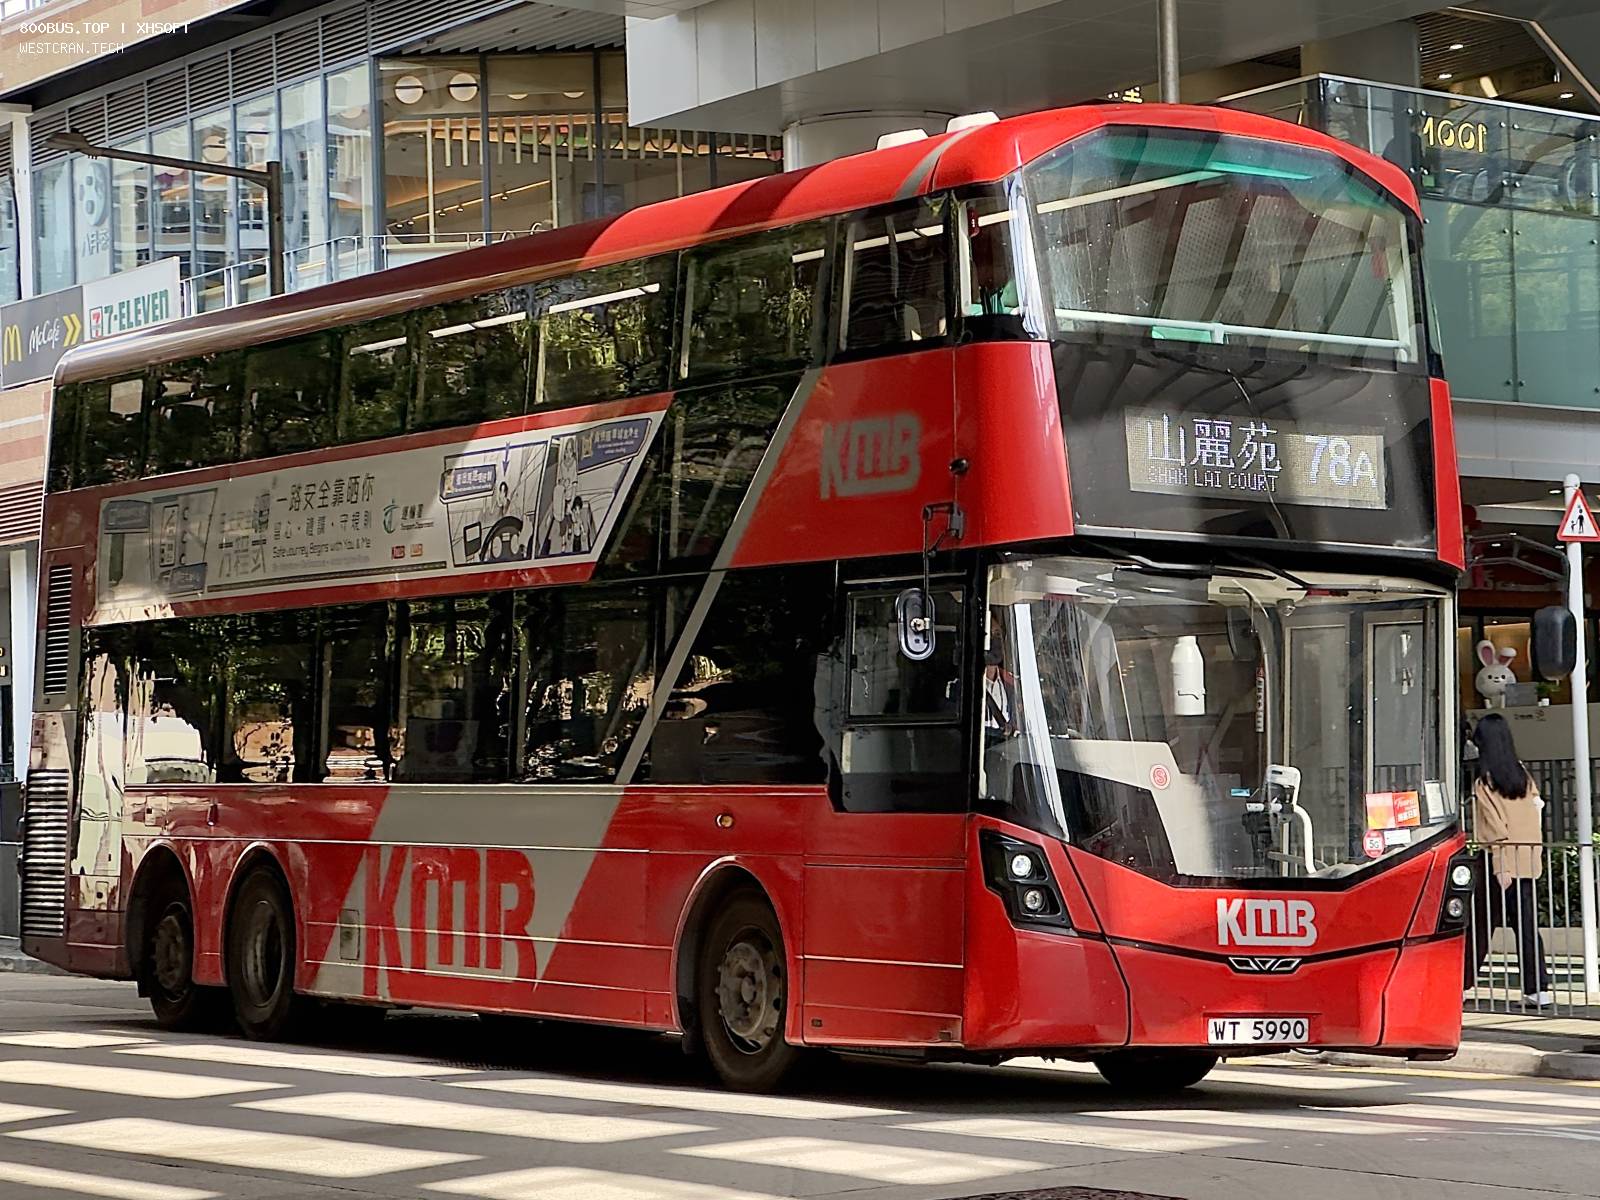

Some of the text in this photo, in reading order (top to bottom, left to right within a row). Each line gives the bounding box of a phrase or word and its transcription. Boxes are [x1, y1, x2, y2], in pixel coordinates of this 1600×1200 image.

[819, 409, 922, 500] KMB
[1148, 413, 1282, 472] 山麗苑
[1305, 435, 1378, 488] 78A
[1149, 466, 1279, 493] SHAN LAI COURT
[1216, 897, 1318, 947] KMB
[1213, 1020, 1305, 1041] WT 5990
